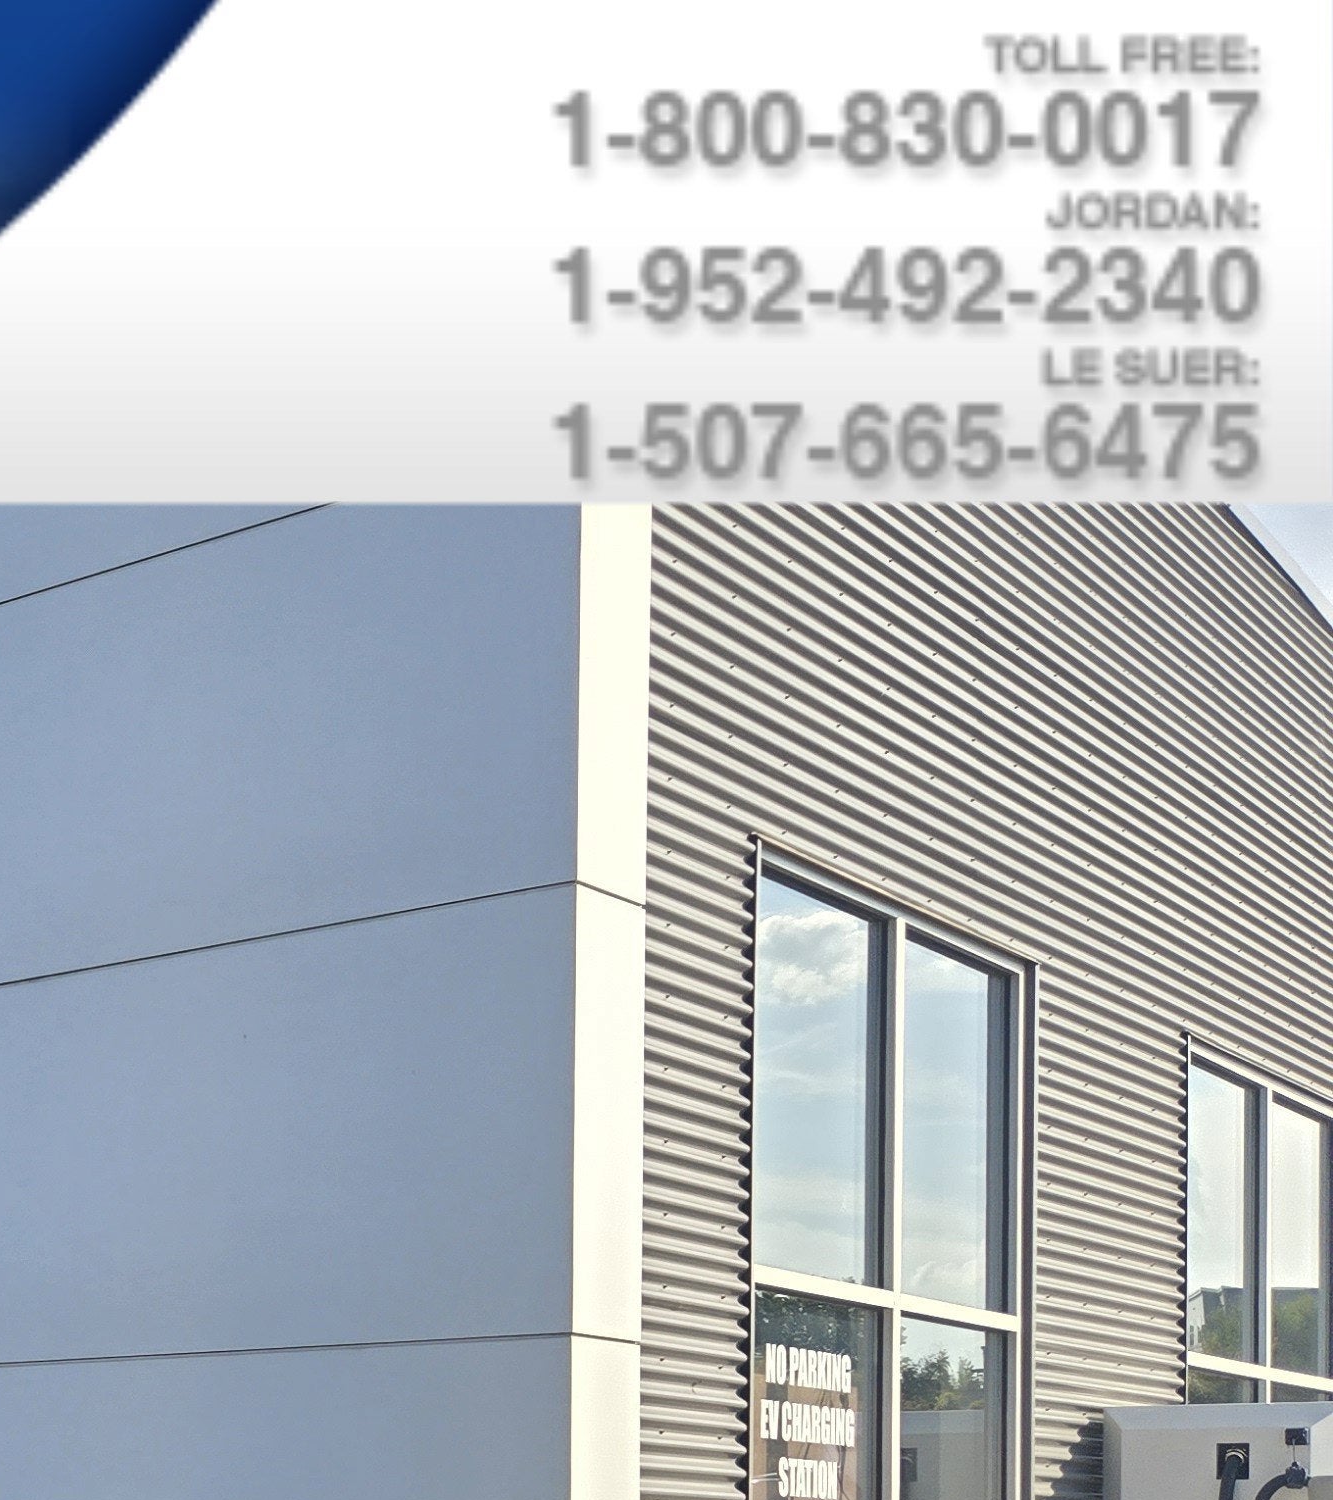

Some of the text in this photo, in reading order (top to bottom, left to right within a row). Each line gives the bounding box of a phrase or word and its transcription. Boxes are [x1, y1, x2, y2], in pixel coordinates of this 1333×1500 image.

[765, 1342, 852, 1394] NO PARKING
[760, 1398, 856, 1448] EV CHARGING
[778, 1456, 838, 1500] STATION
